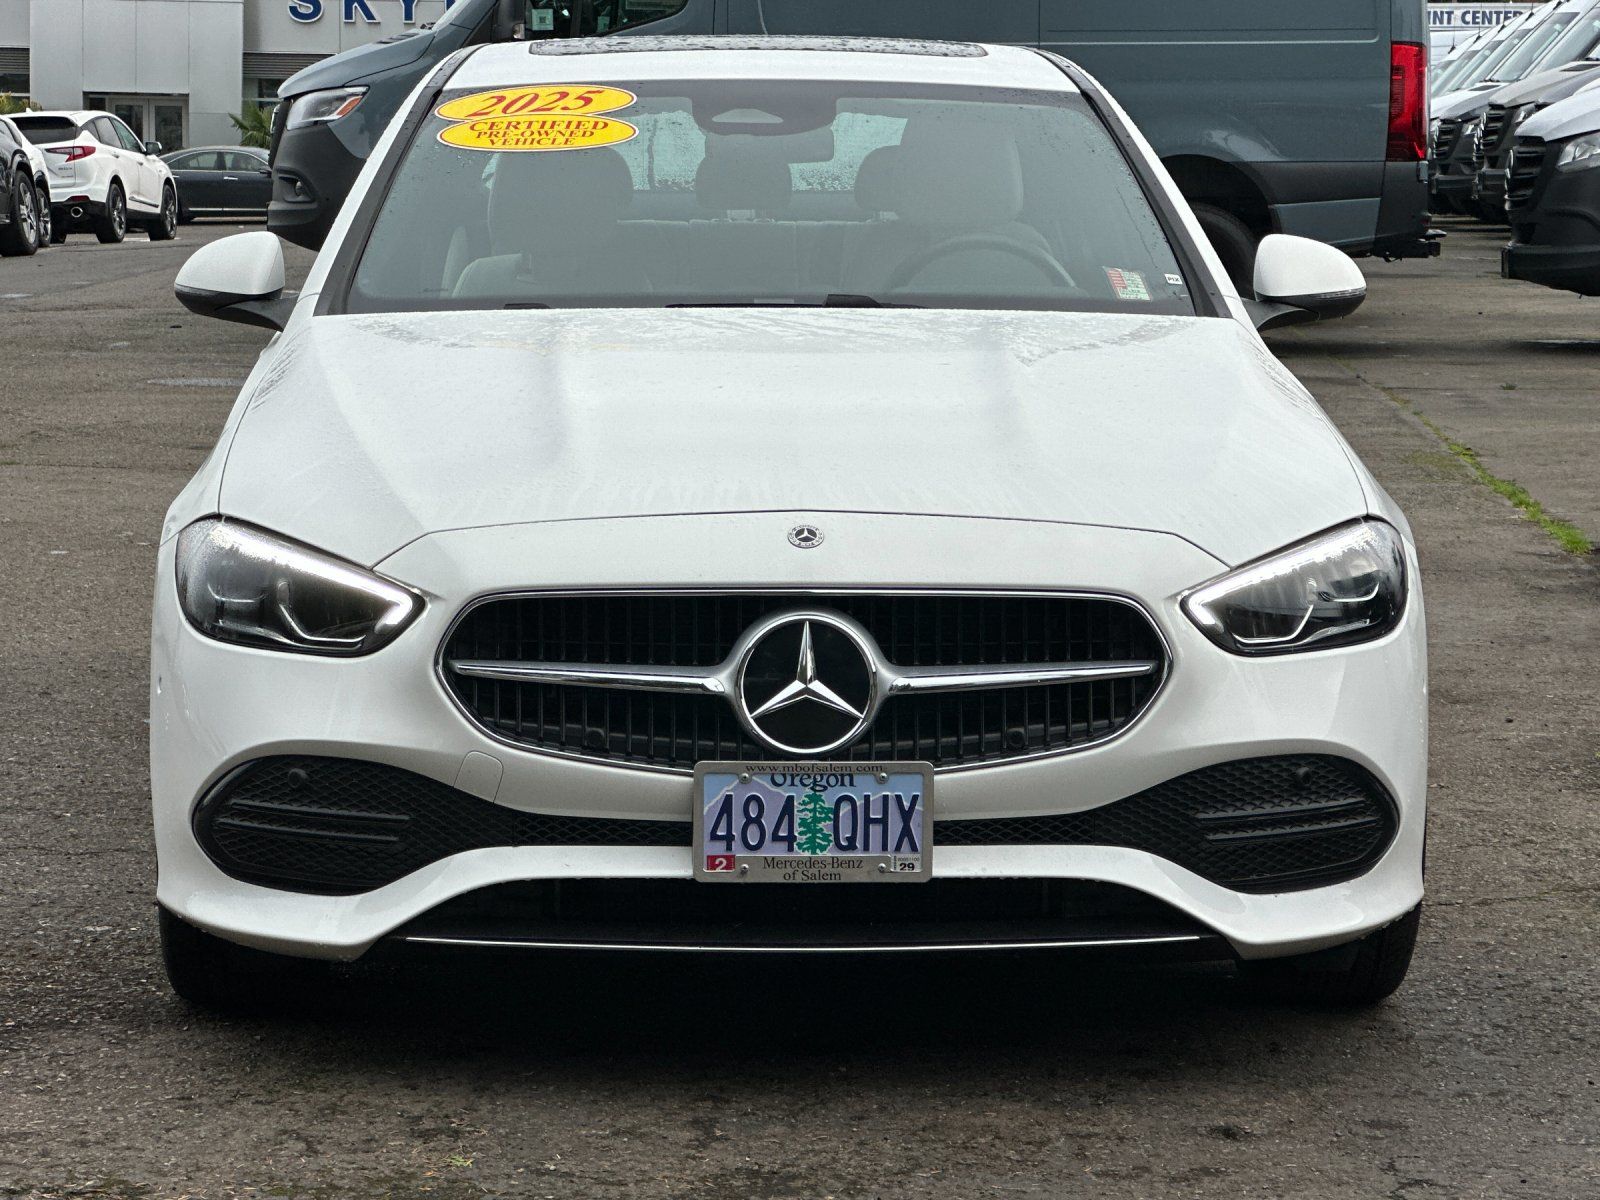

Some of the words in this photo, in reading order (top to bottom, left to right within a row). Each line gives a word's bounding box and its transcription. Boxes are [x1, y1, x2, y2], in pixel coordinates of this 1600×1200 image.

[465, 90, 604, 117] 2025
[469, 120, 609, 132] CERTIFIED
[476, 130, 595, 139] PRE-OWNED
[488, 138, 576, 146] VEHICLE
[746, 763, 884, 774] www.mbofsalem.com
[770, 773, 856, 792] Oregon
[709, 794, 798, 852] 484
[833, 794, 920, 852] QHX
[715, 857, 727, 870] 2
[763, 857, 864, 870] Mercedes-Benz
[899, 862, 916, 871] 29
[783, 870, 798, 882] of
[801, 870, 842, 882] Salem
